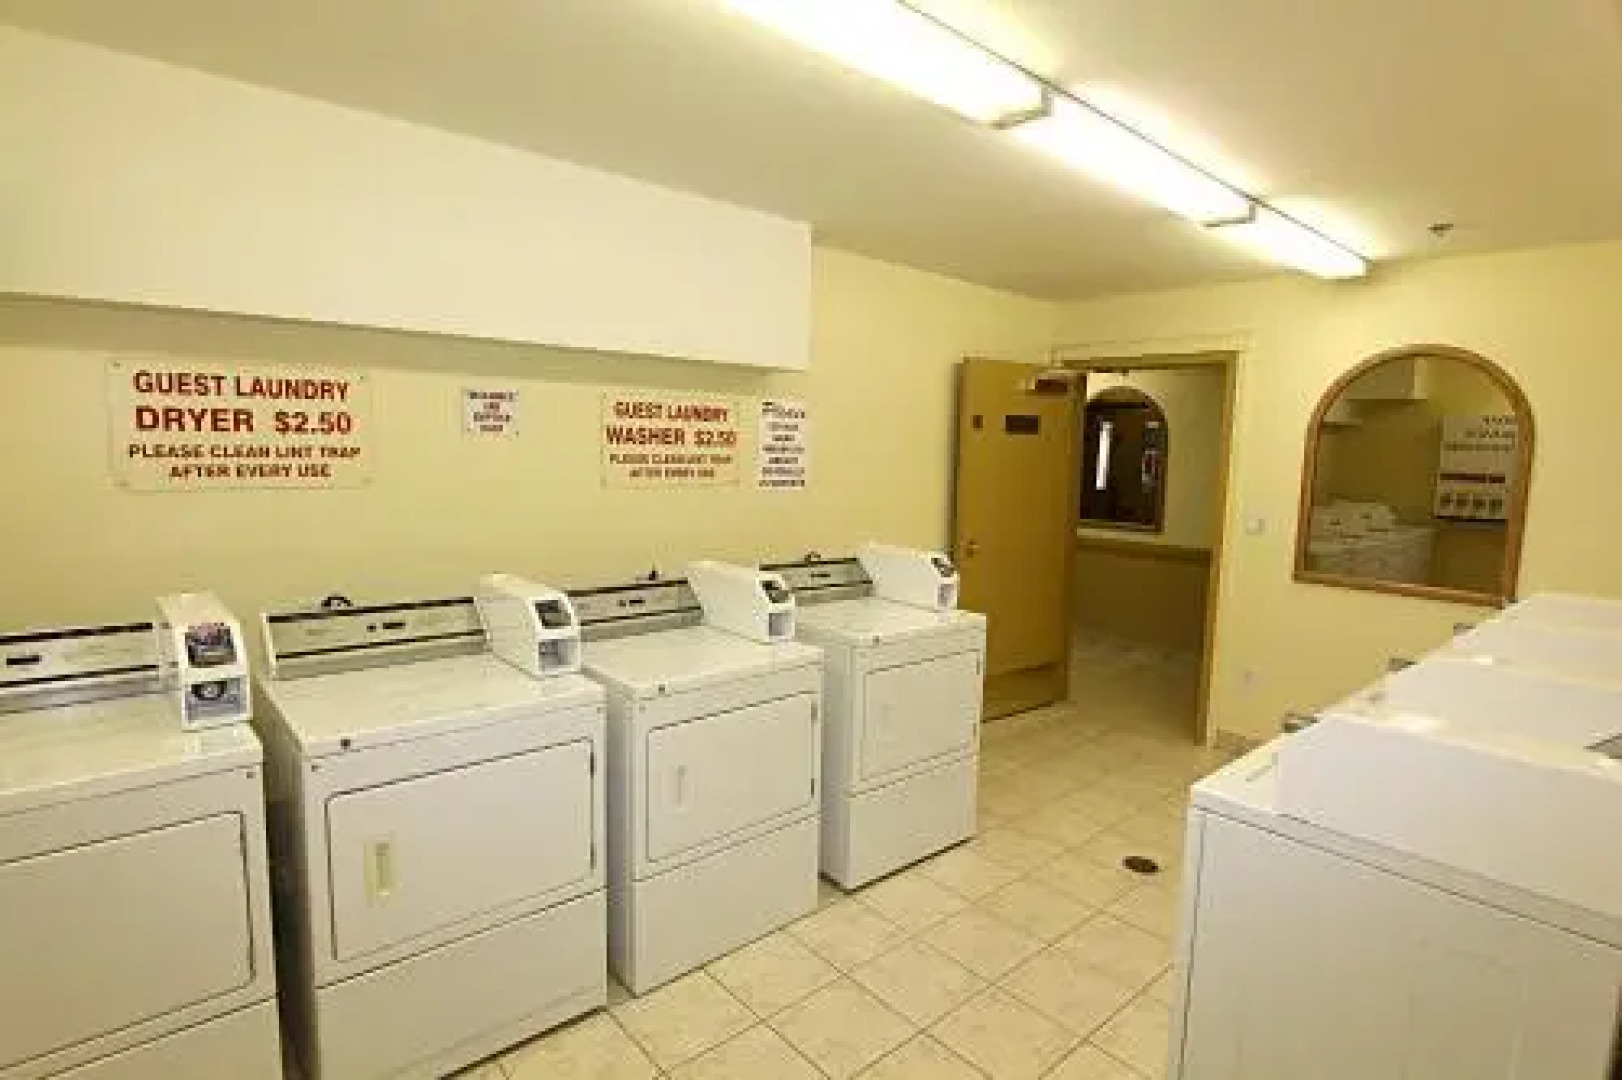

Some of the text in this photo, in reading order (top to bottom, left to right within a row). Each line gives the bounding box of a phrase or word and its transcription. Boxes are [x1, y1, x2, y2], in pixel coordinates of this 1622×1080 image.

[133, 370, 350, 402] GUEST LAUNDRY
[135, 405, 352, 435] DRYER $2.50
[613, 401, 663, 419] GUEST
[606, 425, 686, 445] WASHER
